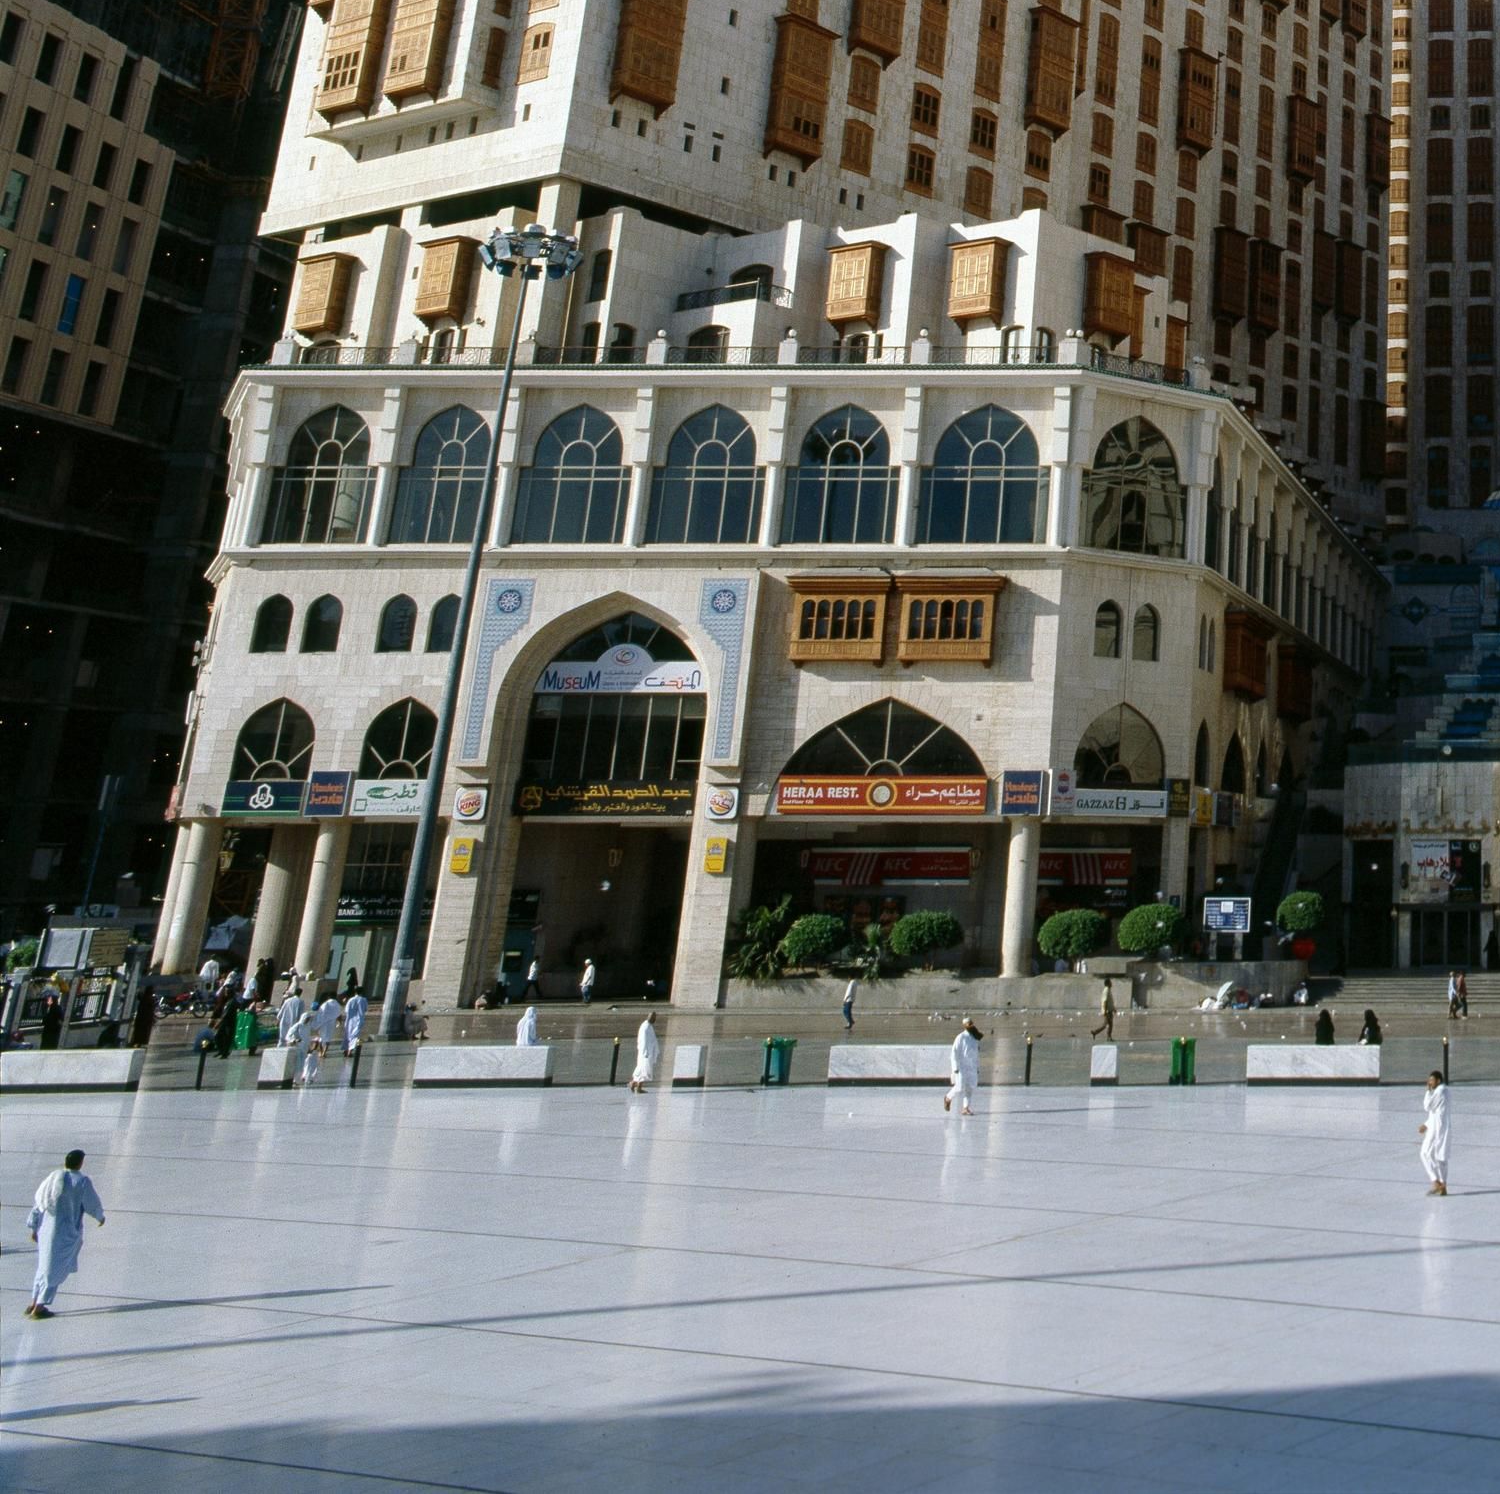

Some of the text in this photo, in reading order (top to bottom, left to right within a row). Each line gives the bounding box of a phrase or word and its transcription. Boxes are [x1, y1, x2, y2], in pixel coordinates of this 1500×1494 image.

[782, 786, 860, 799] HERAA REST.
[905, 785, 981, 801] مطاعم حراء
[459, 799, 481, 810] KING
[1076, 799, 1115, 810] GAZZAZ
[814, 858, 845, 872] KFC
[882, 858, 912, 871] KFC
[1039, 859, 1064, 870] KFC
[1104, 859, 1127, 870] KFC
